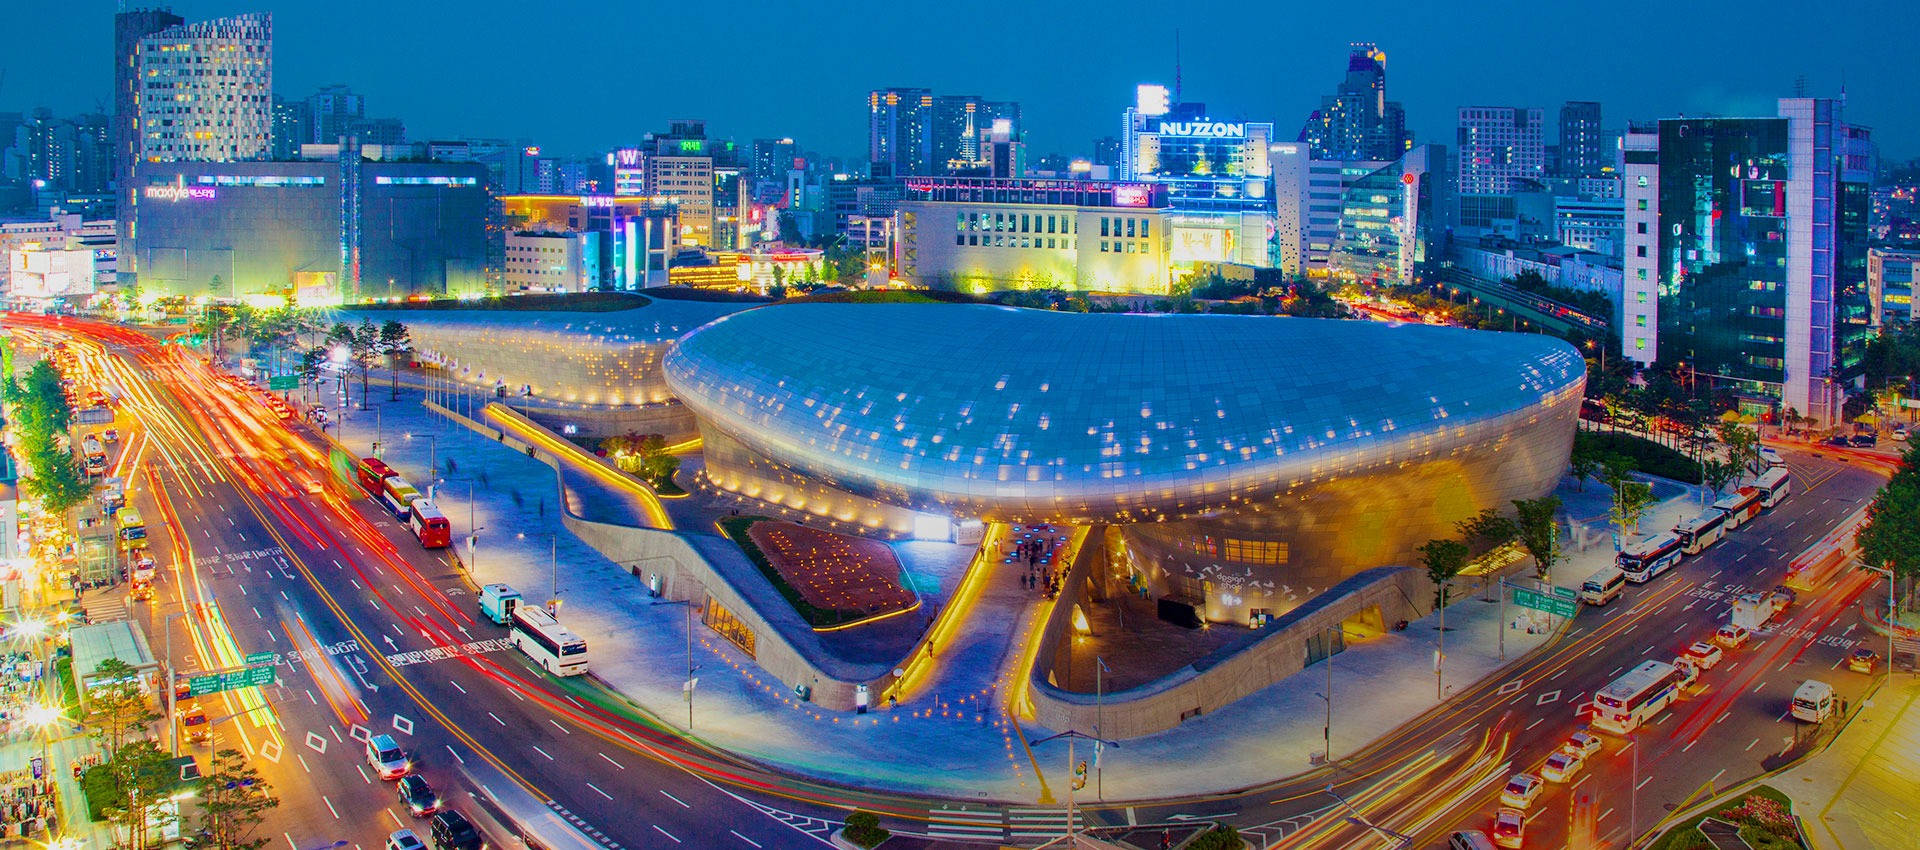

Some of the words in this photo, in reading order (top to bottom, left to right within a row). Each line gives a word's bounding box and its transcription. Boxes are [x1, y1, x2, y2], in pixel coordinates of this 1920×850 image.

[1159, 122, 1244, 137] NUZZON
[621, 150, 637, 165] W
[1217, 572, 1246, 585] design
